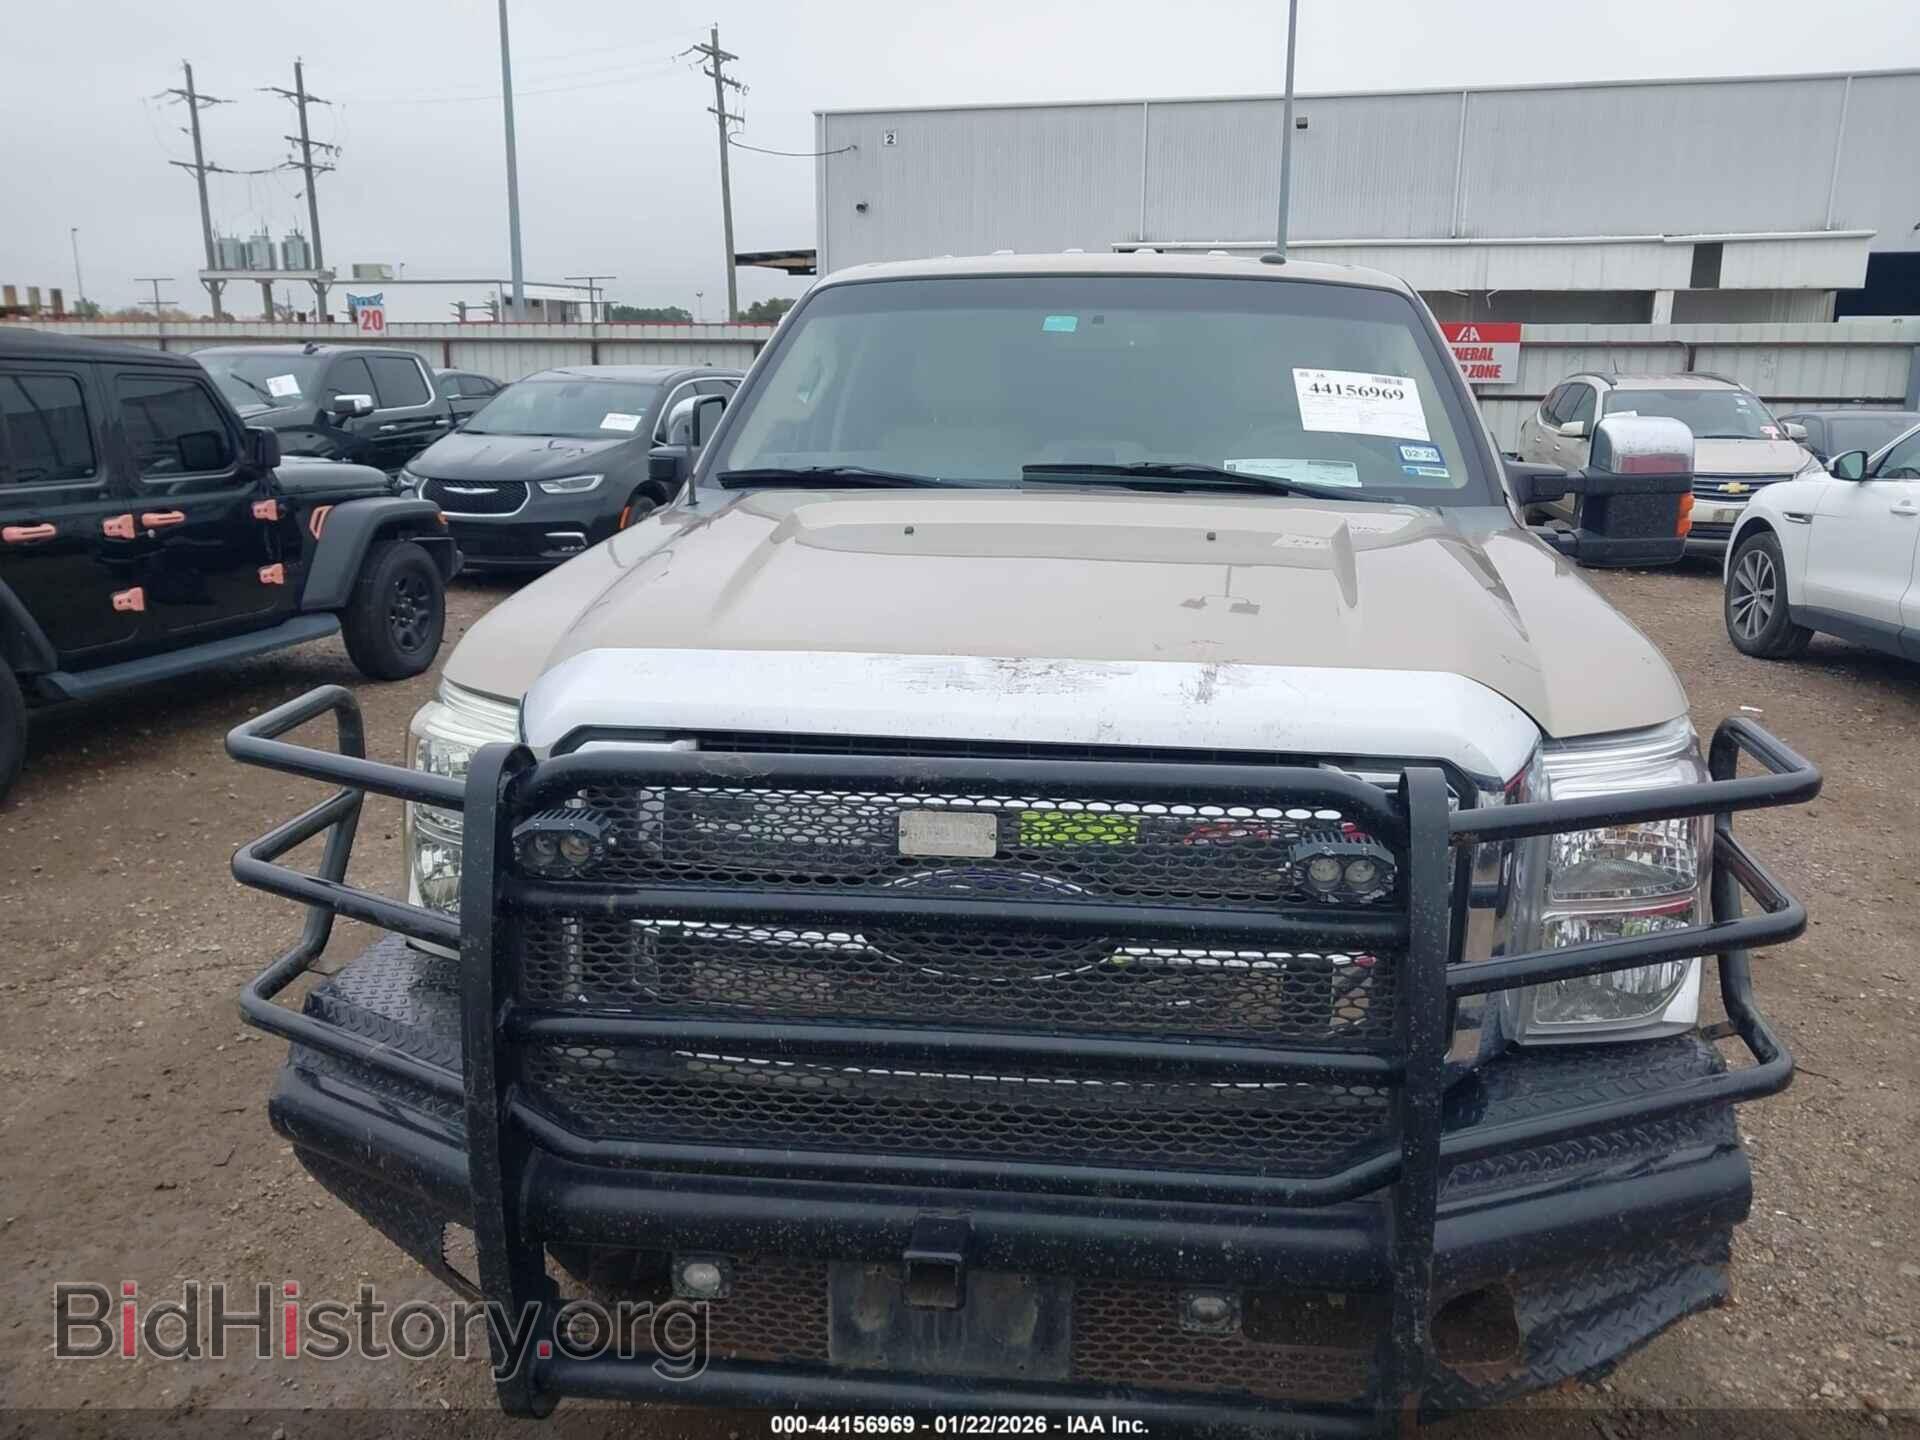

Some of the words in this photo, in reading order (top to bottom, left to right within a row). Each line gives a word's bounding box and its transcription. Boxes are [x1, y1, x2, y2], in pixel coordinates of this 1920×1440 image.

[886, 134, 895, 144] 2
[361, 309, 384, 331] 20
[1452, 347, 1494, 361] NERAL
[1468, 364, 1503, 378] ZONE
[1309, 382, 1405, 401] 44156969
